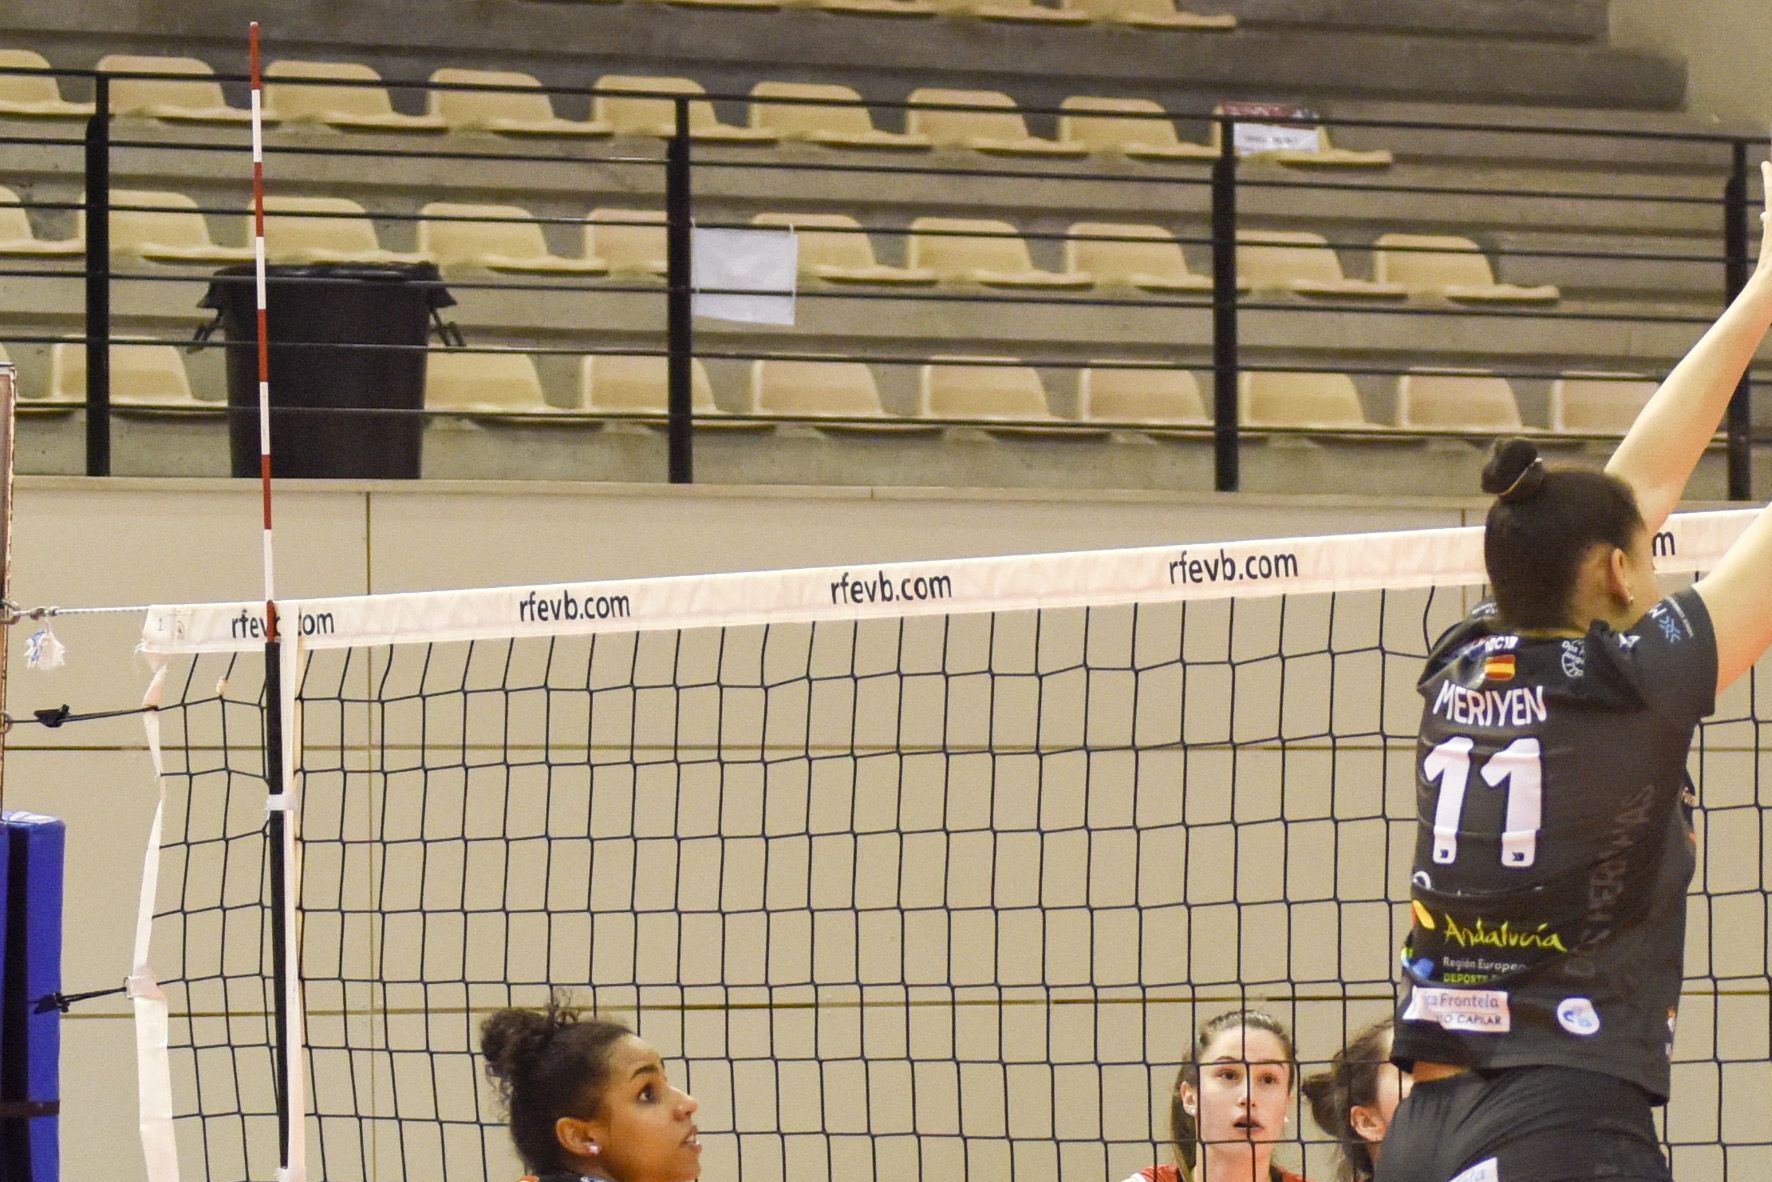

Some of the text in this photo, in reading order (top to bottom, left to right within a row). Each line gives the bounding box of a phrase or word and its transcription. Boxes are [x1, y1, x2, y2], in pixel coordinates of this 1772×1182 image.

[1168, 548, 1298, 585] rfevb.com
[519, 590, 631, 622] rfevb.com
[830, 570, 952, 605] rfevb.com
[1433, 680, 1547, 727] MERIYEN
[1423, 735, 1542, 867] 11
[1444, 913, 1568, 952] Andalucía
